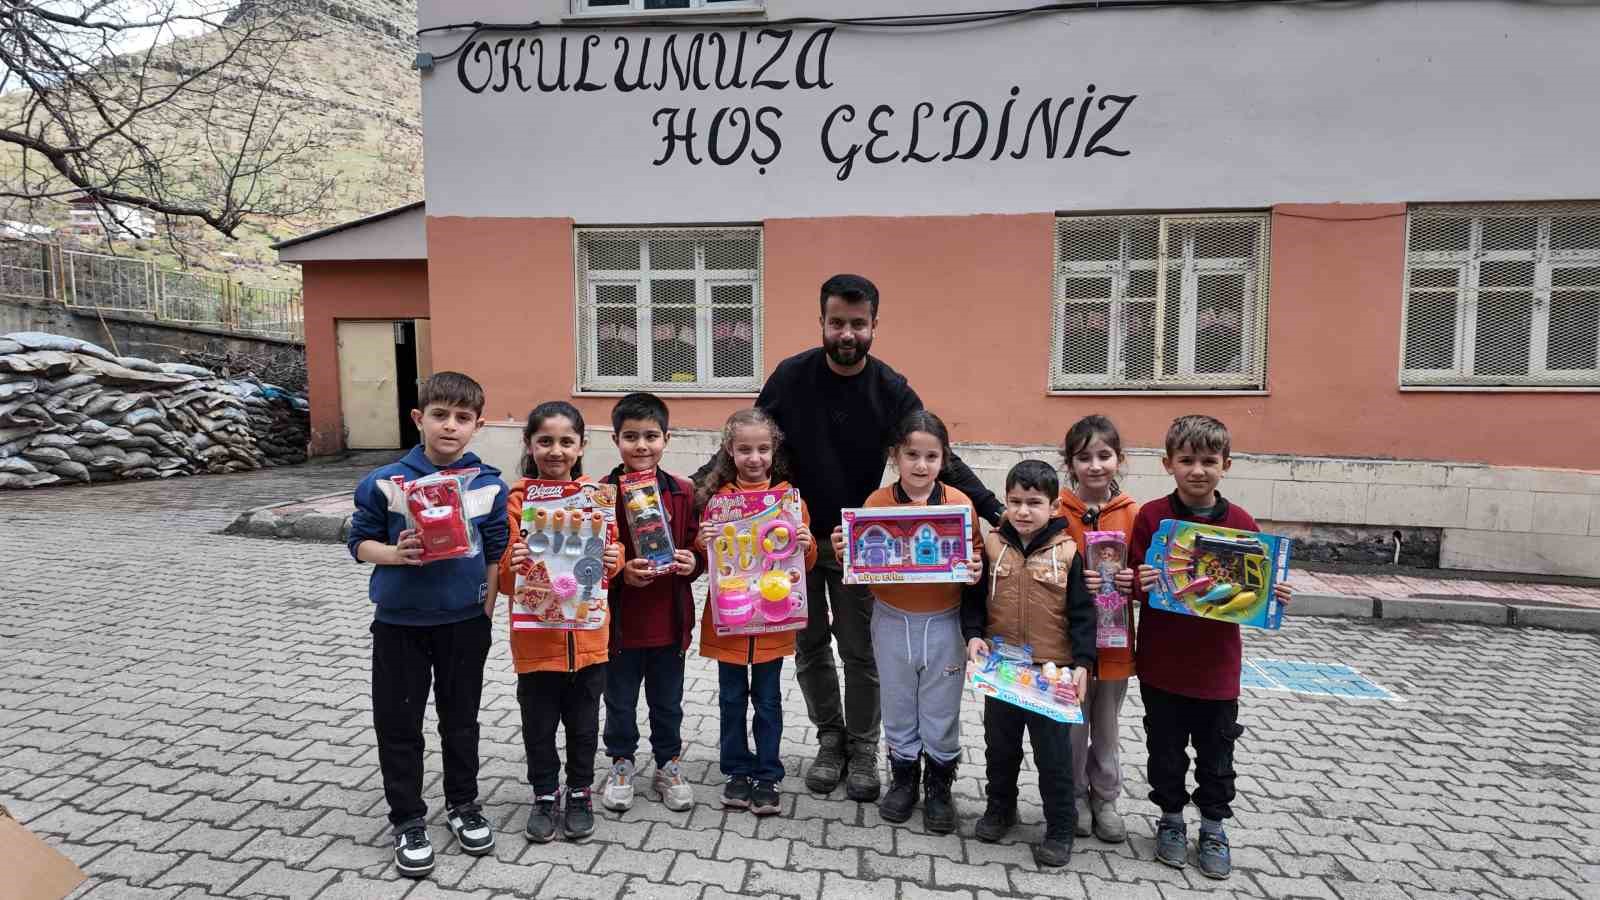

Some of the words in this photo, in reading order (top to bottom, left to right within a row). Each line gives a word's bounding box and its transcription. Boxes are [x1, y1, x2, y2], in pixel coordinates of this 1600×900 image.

[457, 26, 836, 93] OKULUMUZA
[652, 105, 783, 175] HOŞ
[820, 83, 1138, 182] GELDİNİZ
